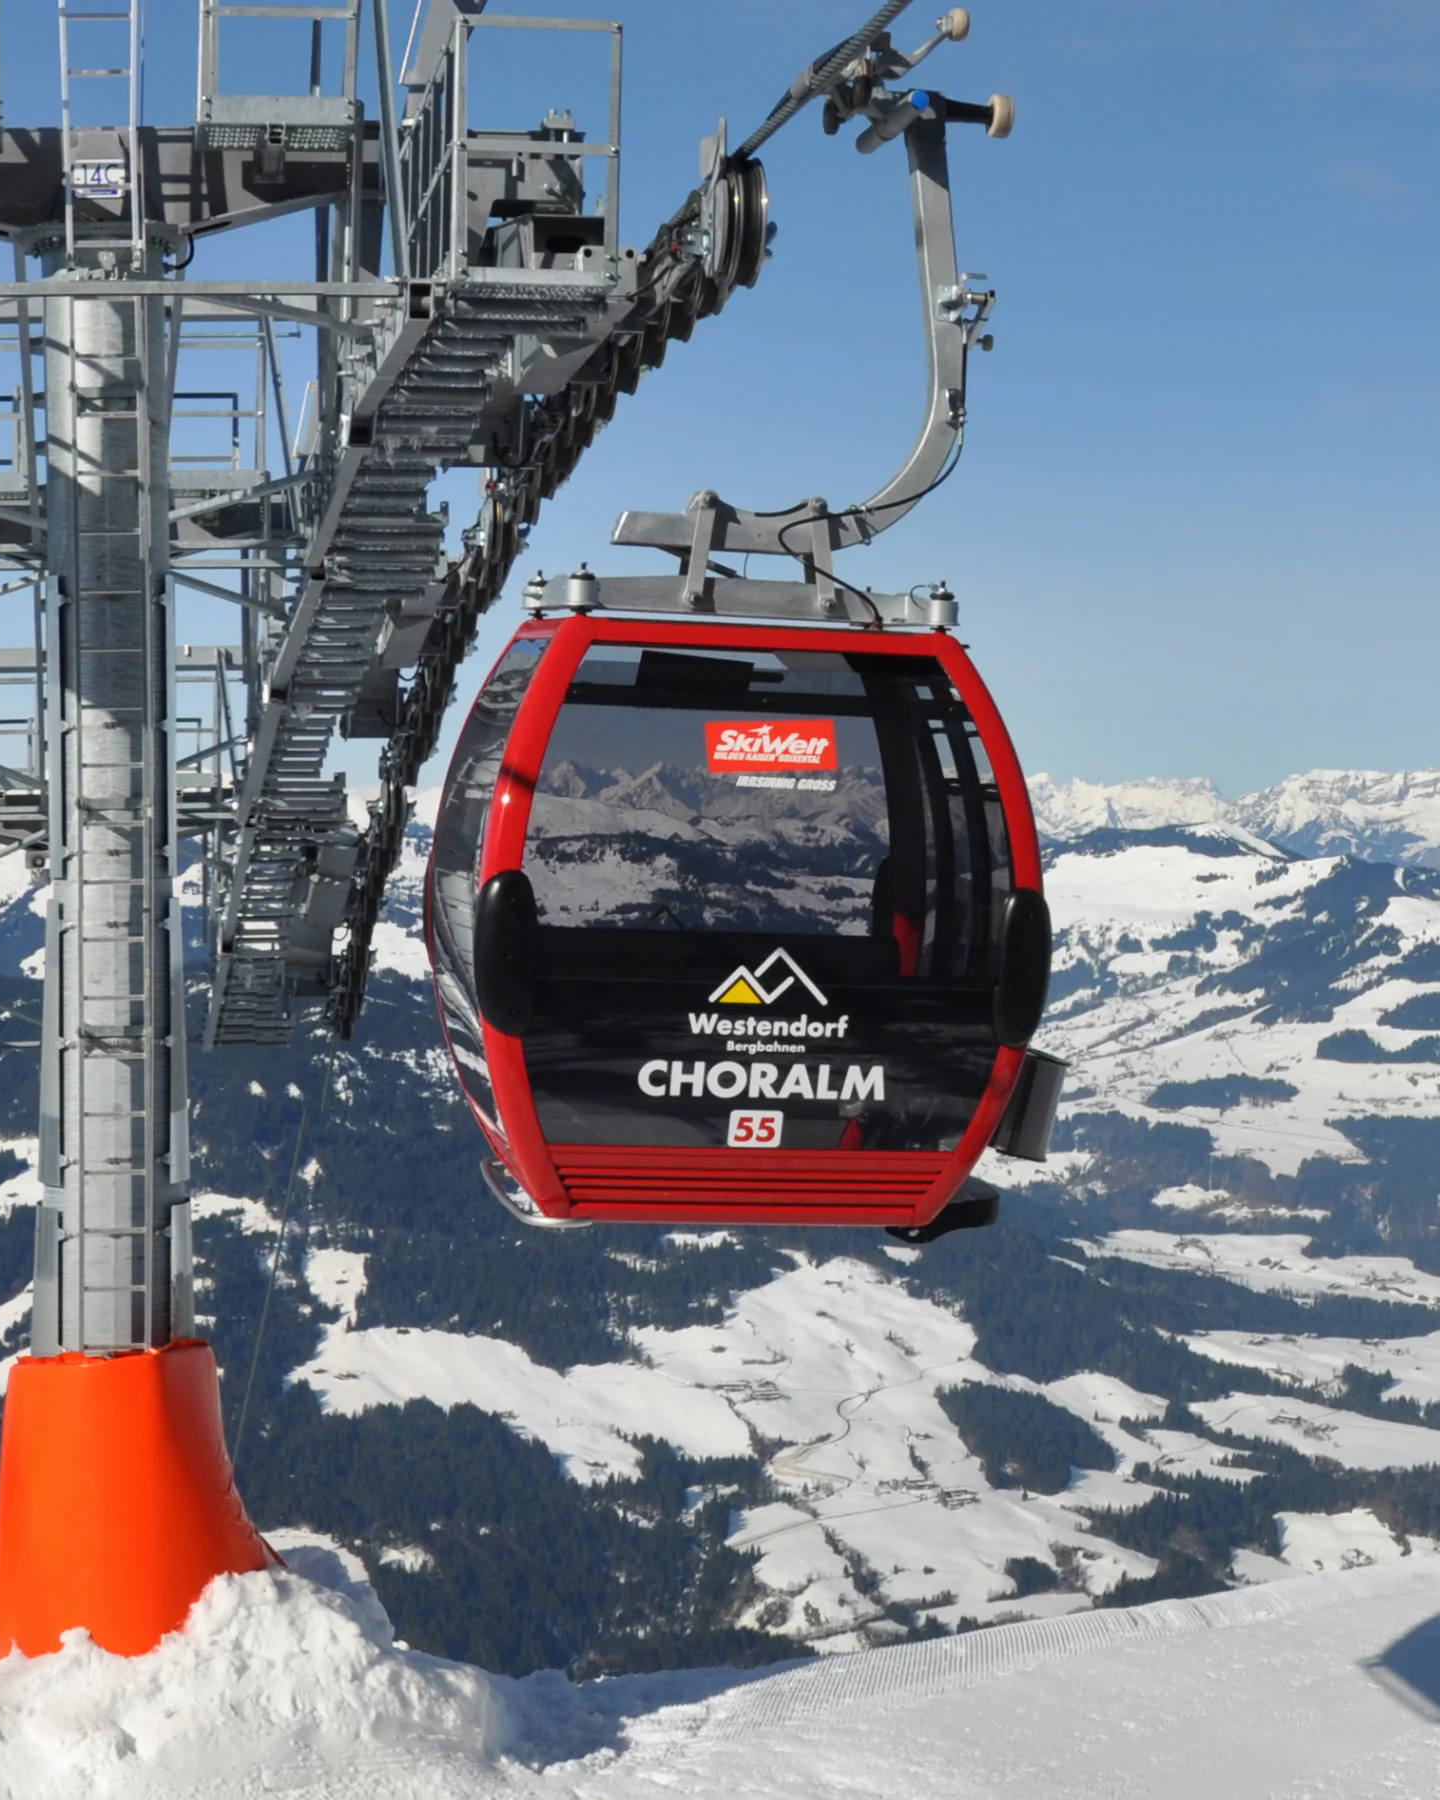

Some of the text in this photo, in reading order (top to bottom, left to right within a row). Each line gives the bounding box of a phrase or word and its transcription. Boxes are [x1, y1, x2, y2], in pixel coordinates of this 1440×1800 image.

[81, 163, 119, 186] 14C
[715, 729, 830, 756] SkiWelt
[735, 775, 837, 792] IRRSINNIG GROSS
[688, 1012, 849, 1038] Westendorf
[726, 1040, 806, 1055] Bergbahnen
[637, 1059, 885, 1101] CHORALM
[733, 1116, 776, 1143] 55
